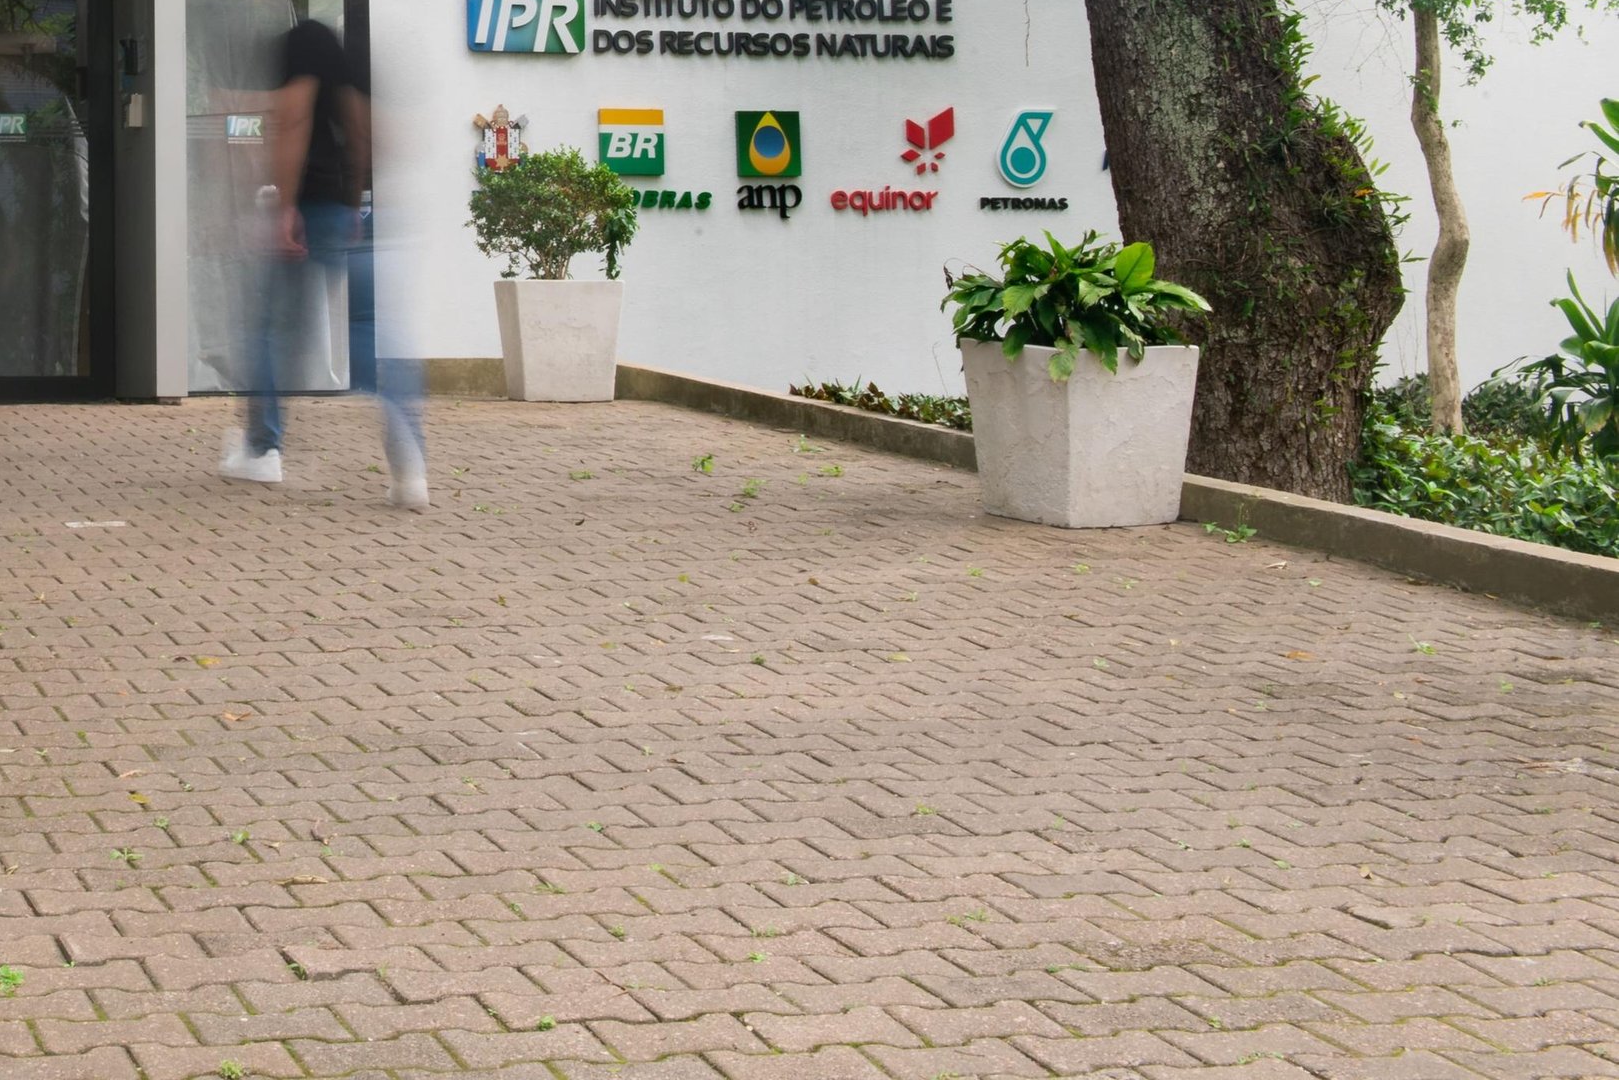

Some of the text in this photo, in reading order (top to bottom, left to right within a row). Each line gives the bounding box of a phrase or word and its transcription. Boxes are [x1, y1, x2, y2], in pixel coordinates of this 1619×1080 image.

[593, 29, 955, 58] DOS RECURSOS NATURAIS
[230, 115, 262, 136] IPR
[607, 133, 658, 158] BR
[736, 183, 802, 219] anp
[830, 185, 938, 217] equinor
[980, 197, 1069, 210] PETRONAS
